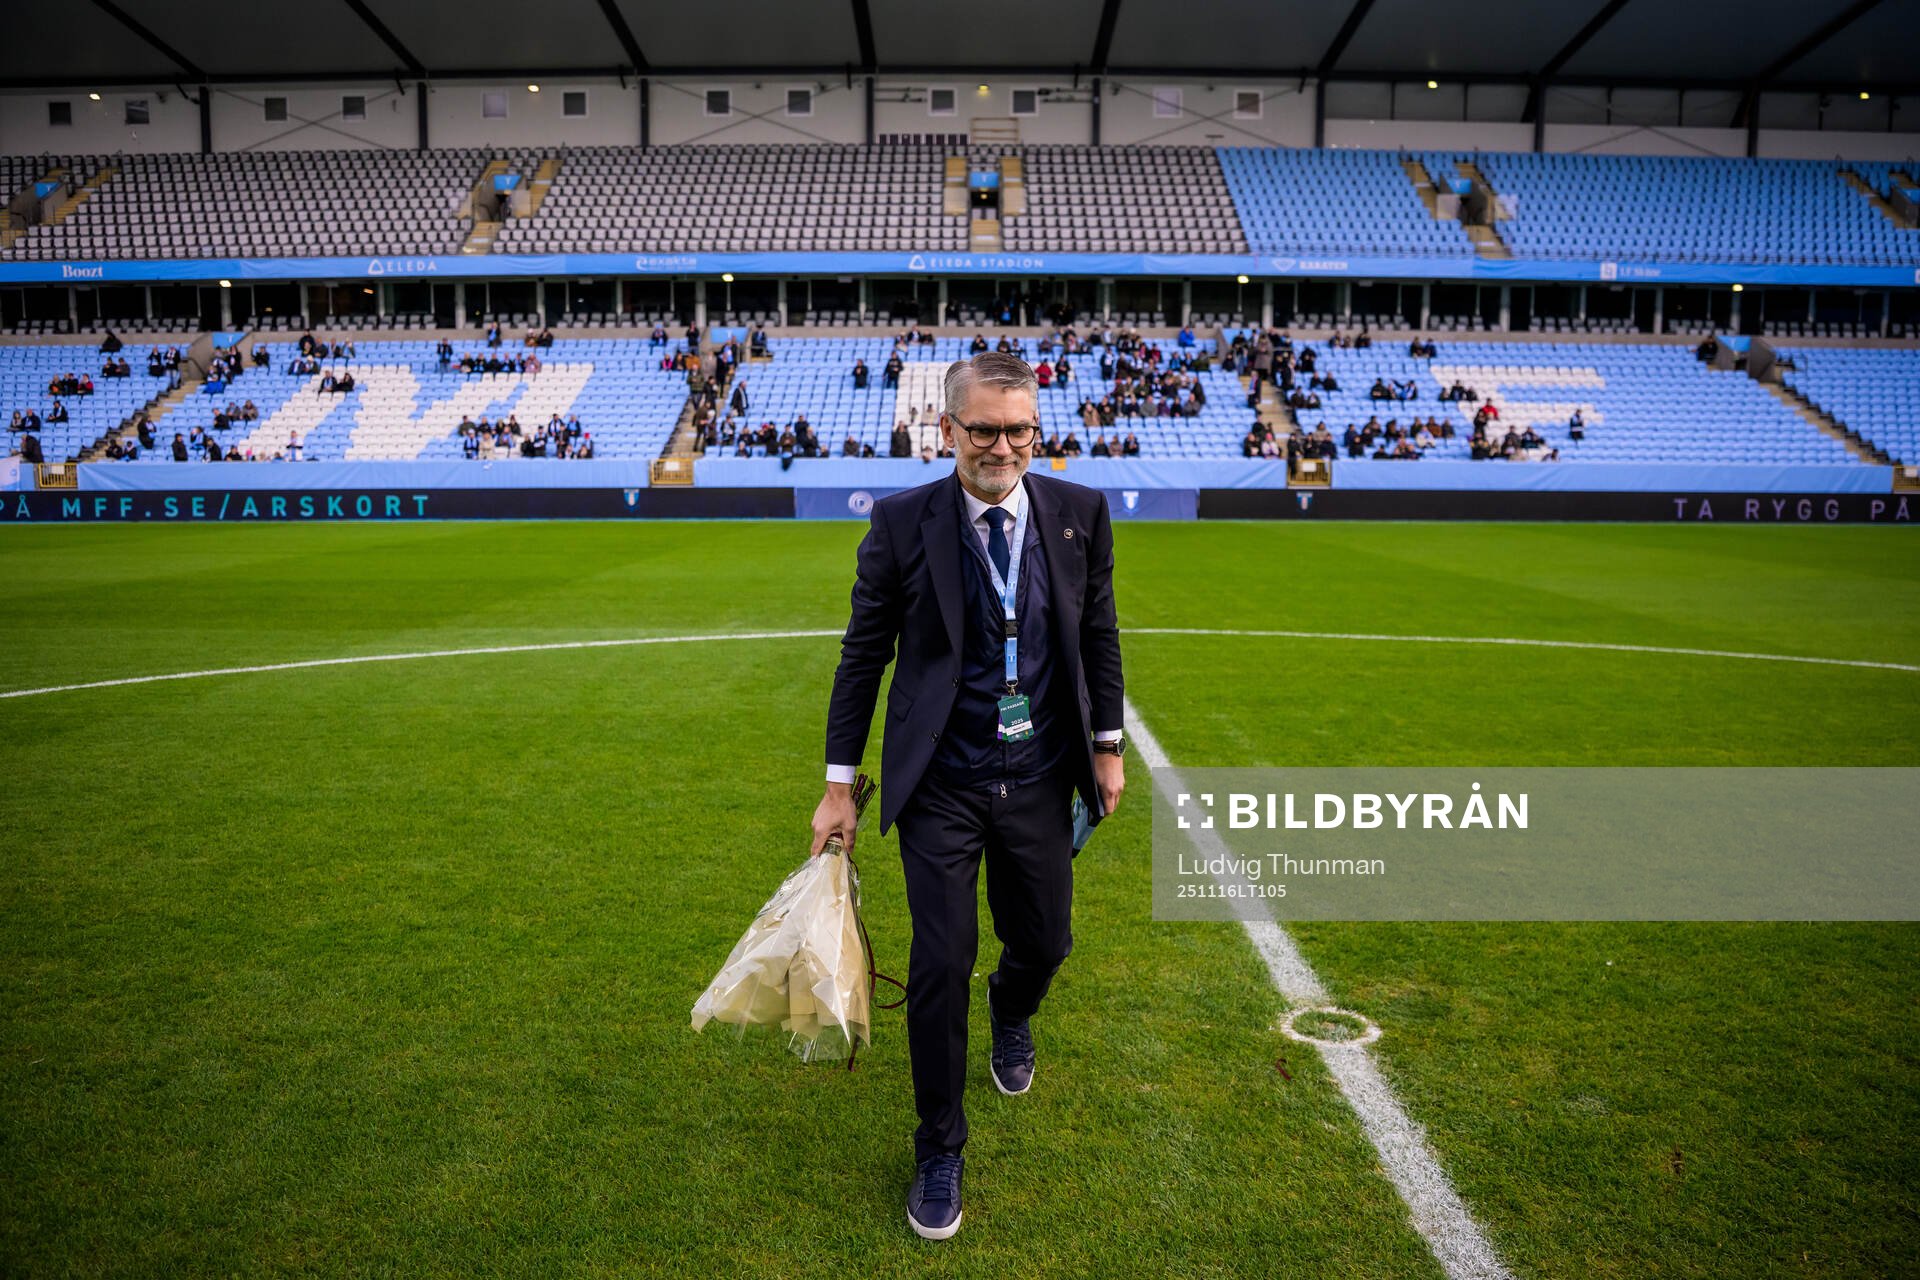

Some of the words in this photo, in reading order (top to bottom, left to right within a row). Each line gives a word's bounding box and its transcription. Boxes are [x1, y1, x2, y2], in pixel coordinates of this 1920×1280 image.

[386, 260, 437, 272] ELEDA
[930, 258, 973, 268] ELEDA
[981, 258, 1043, 268] STADION
[62, 264, 103, 278] Boozt
[1673, 498, 1714, 520] TA
[1744, 498, 1840, 521] RYGG
[1870, 496, 1910, 521] PÅ
